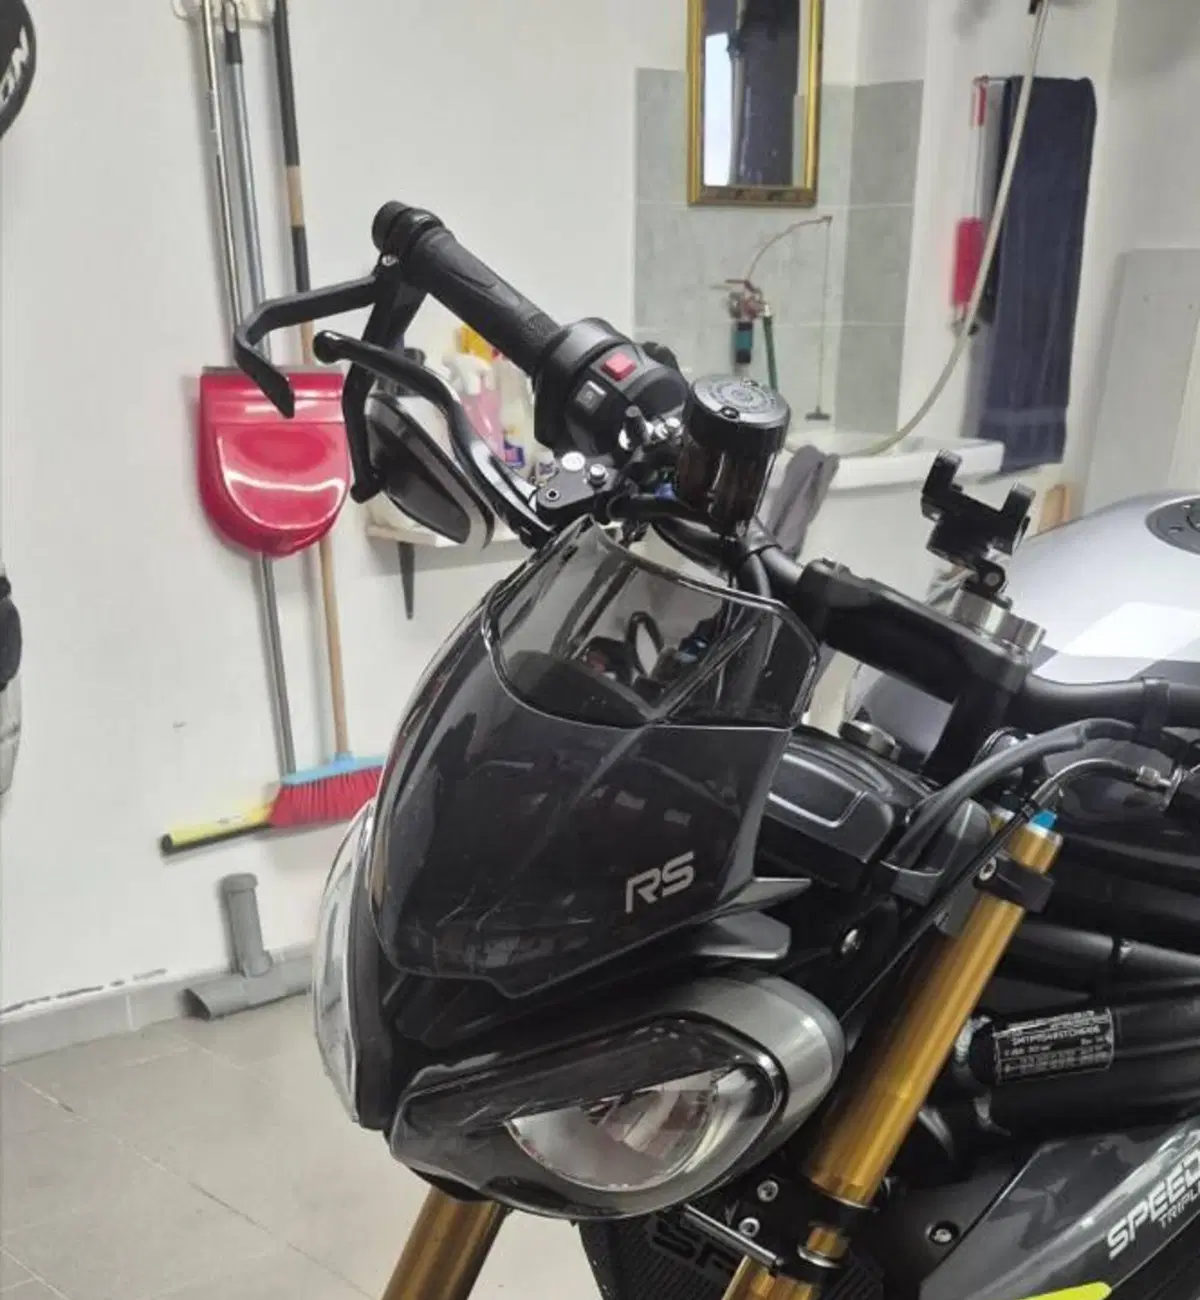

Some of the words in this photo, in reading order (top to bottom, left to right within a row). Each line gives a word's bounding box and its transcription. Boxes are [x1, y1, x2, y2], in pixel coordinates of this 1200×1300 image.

[625, 851, 694, 914] RS
[1107, 1149, 1200, 1260] SPEED
[1158, 1181, 1200, 1229] TRIPL
